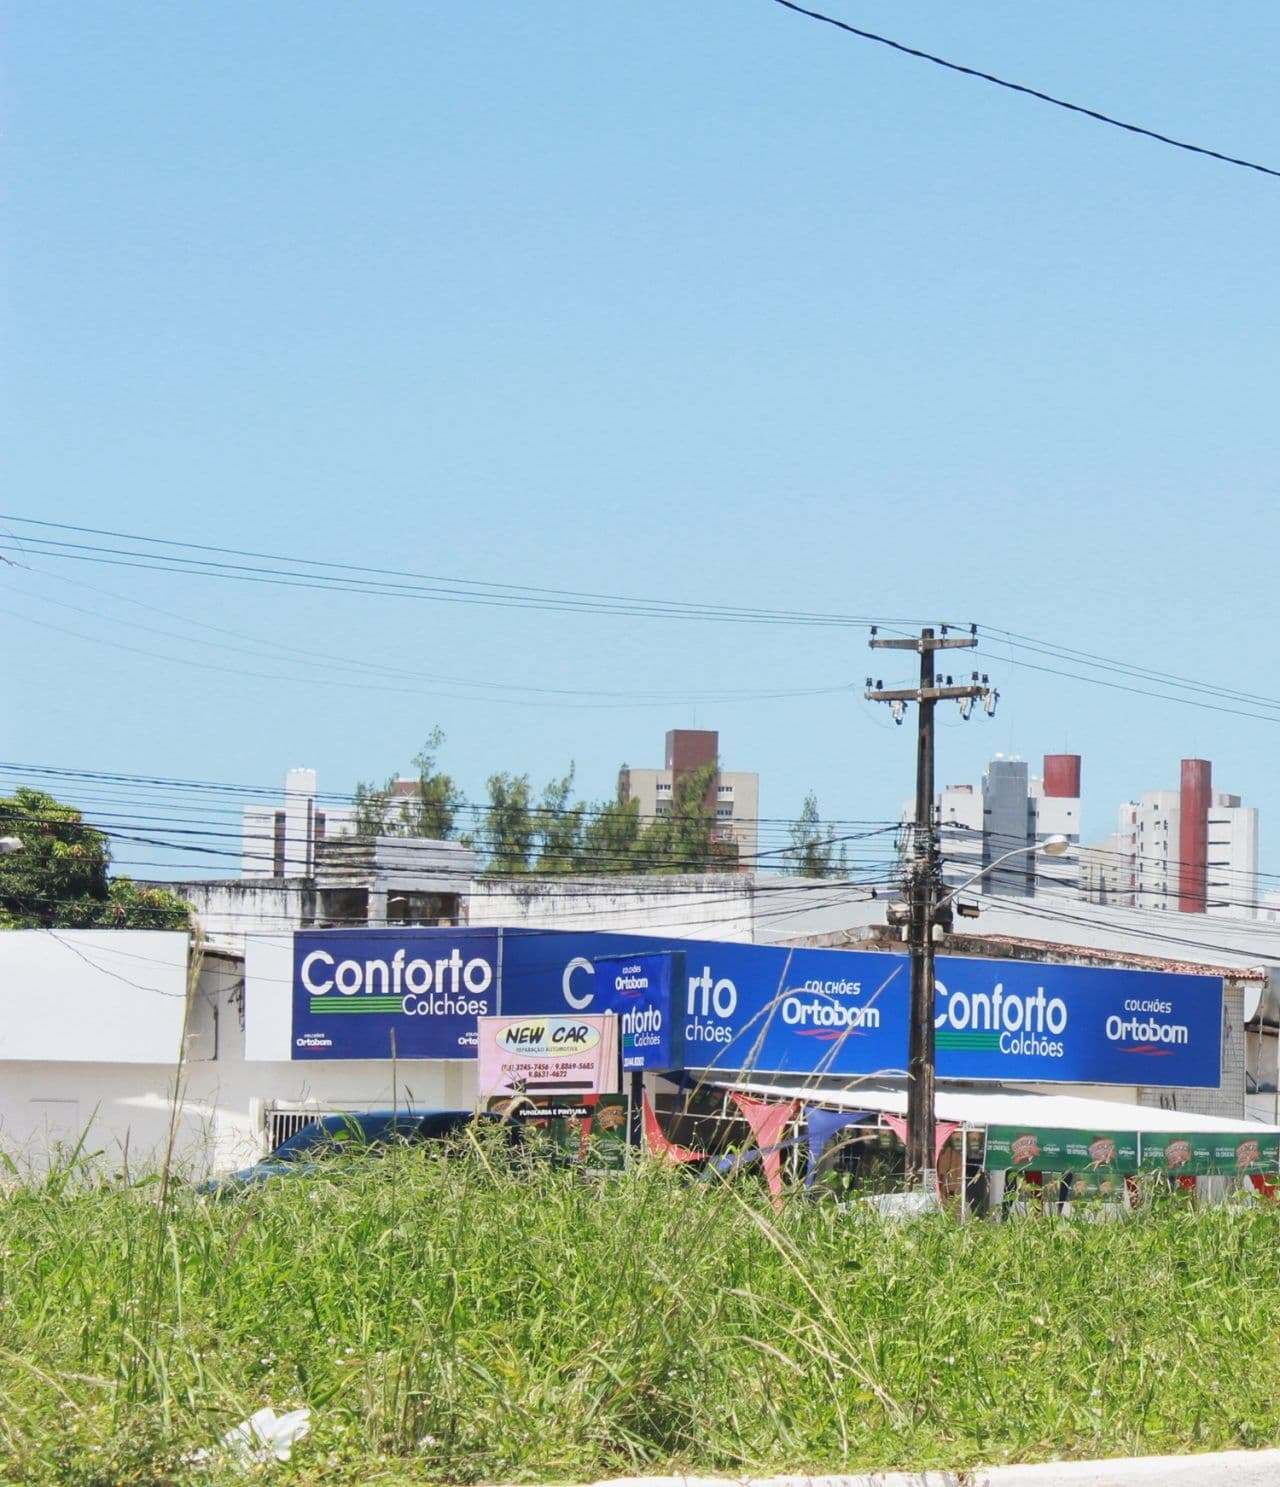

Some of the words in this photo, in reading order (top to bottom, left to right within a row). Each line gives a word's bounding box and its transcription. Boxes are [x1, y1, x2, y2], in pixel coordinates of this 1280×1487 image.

[301, 948, 492, 996] Conforto
[615, 976, 649, 991] Ortobom
[805, 979, 861, 995] COLCHÕES
[402, 993, 488, 1016] Colchões
[782, 997, 880, 1028] Ortobom
[1124, 999, 1173, 1014] COLCHÕES
[506, 1026, 544, 1044] NEW
[551, 1026, 589, 1043] CAR
[634, 1032, 661, 1047] Colchões
[1105, 1015, 1188, 1044] Ortobom
[999, 1031, 1064, 1058] Colchões
